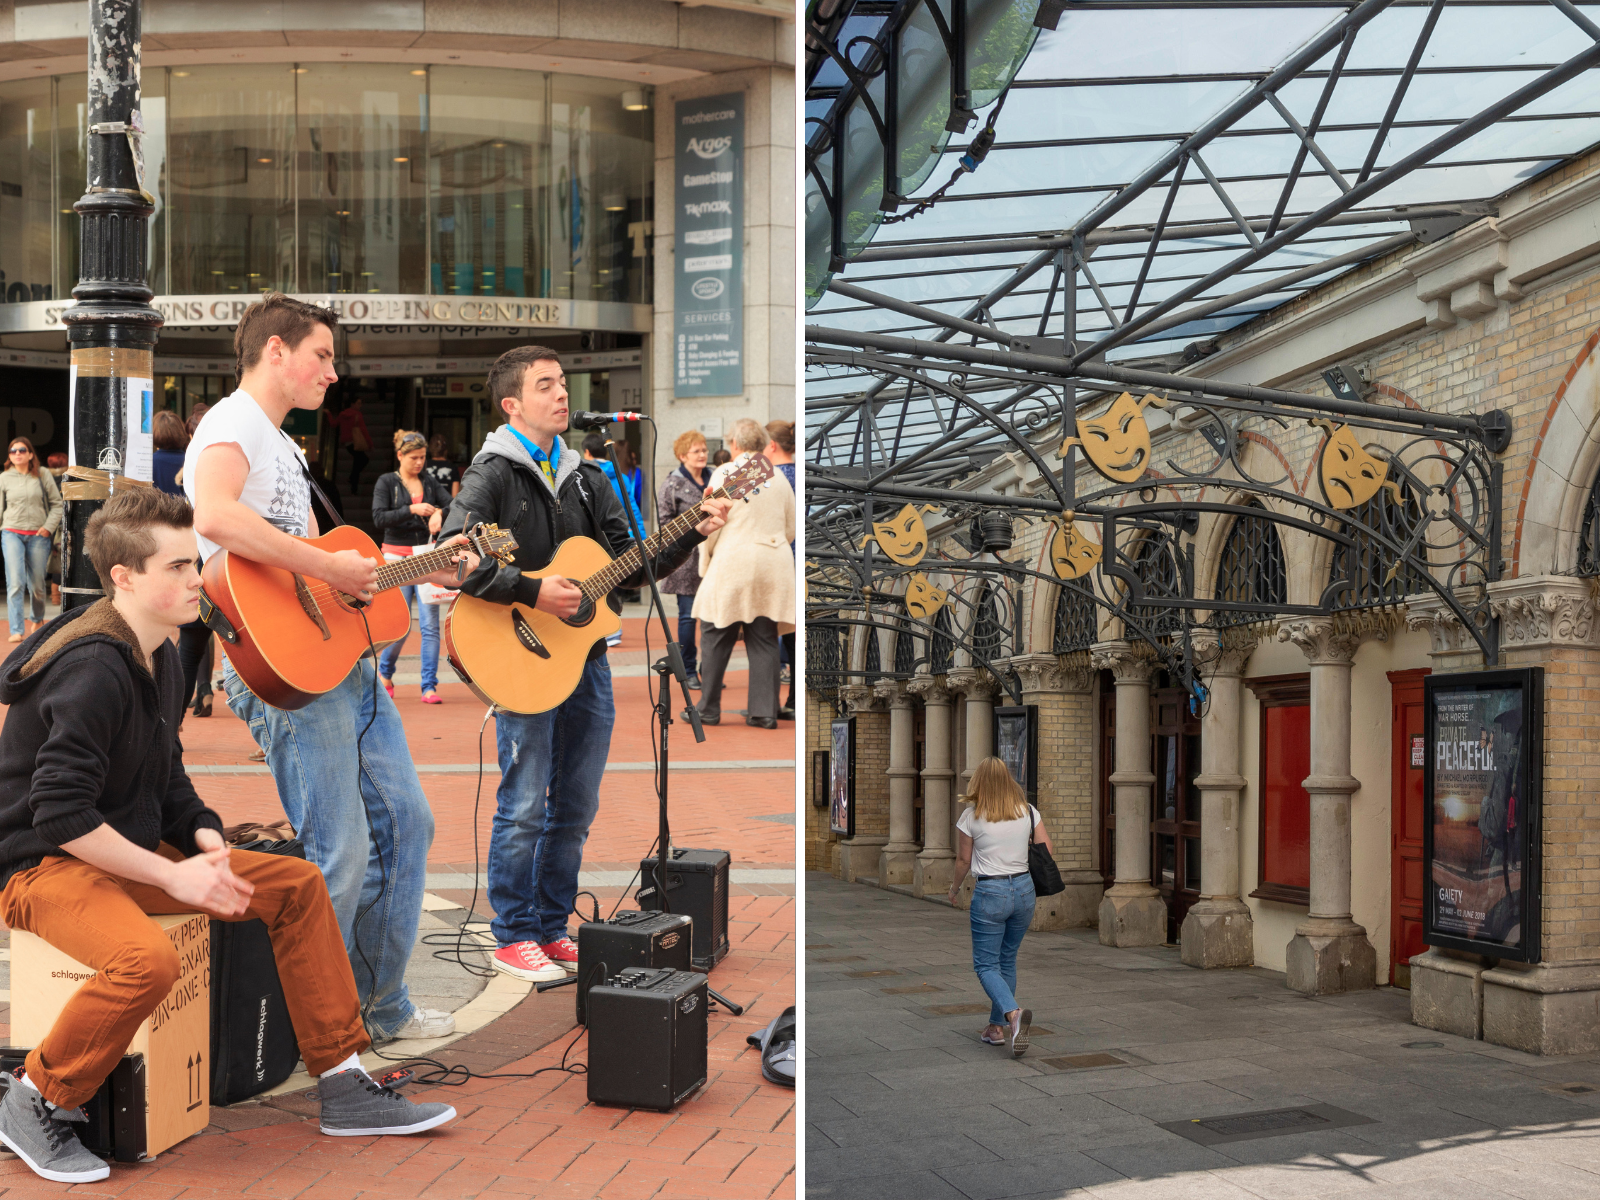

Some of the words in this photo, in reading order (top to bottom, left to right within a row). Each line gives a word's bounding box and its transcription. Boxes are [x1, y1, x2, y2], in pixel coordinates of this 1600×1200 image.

[682, 110, 736, 125] mothercare
[686, 136, 732, 156] Argos
[684, 171, 733, 188] GameStop
[459, 301, 560, 323] CENTRE
[684, 312, 732, 324] SERVICES
[1437, 713, 1449, 722] WAR
[1440, 726, 1467, 743] PRIVATE
[1438, 887, 1463, 904] GAIETY
[1462, 909, 1474, 919] JUNE
[256, 998, 267, 1070] schlagwerk
